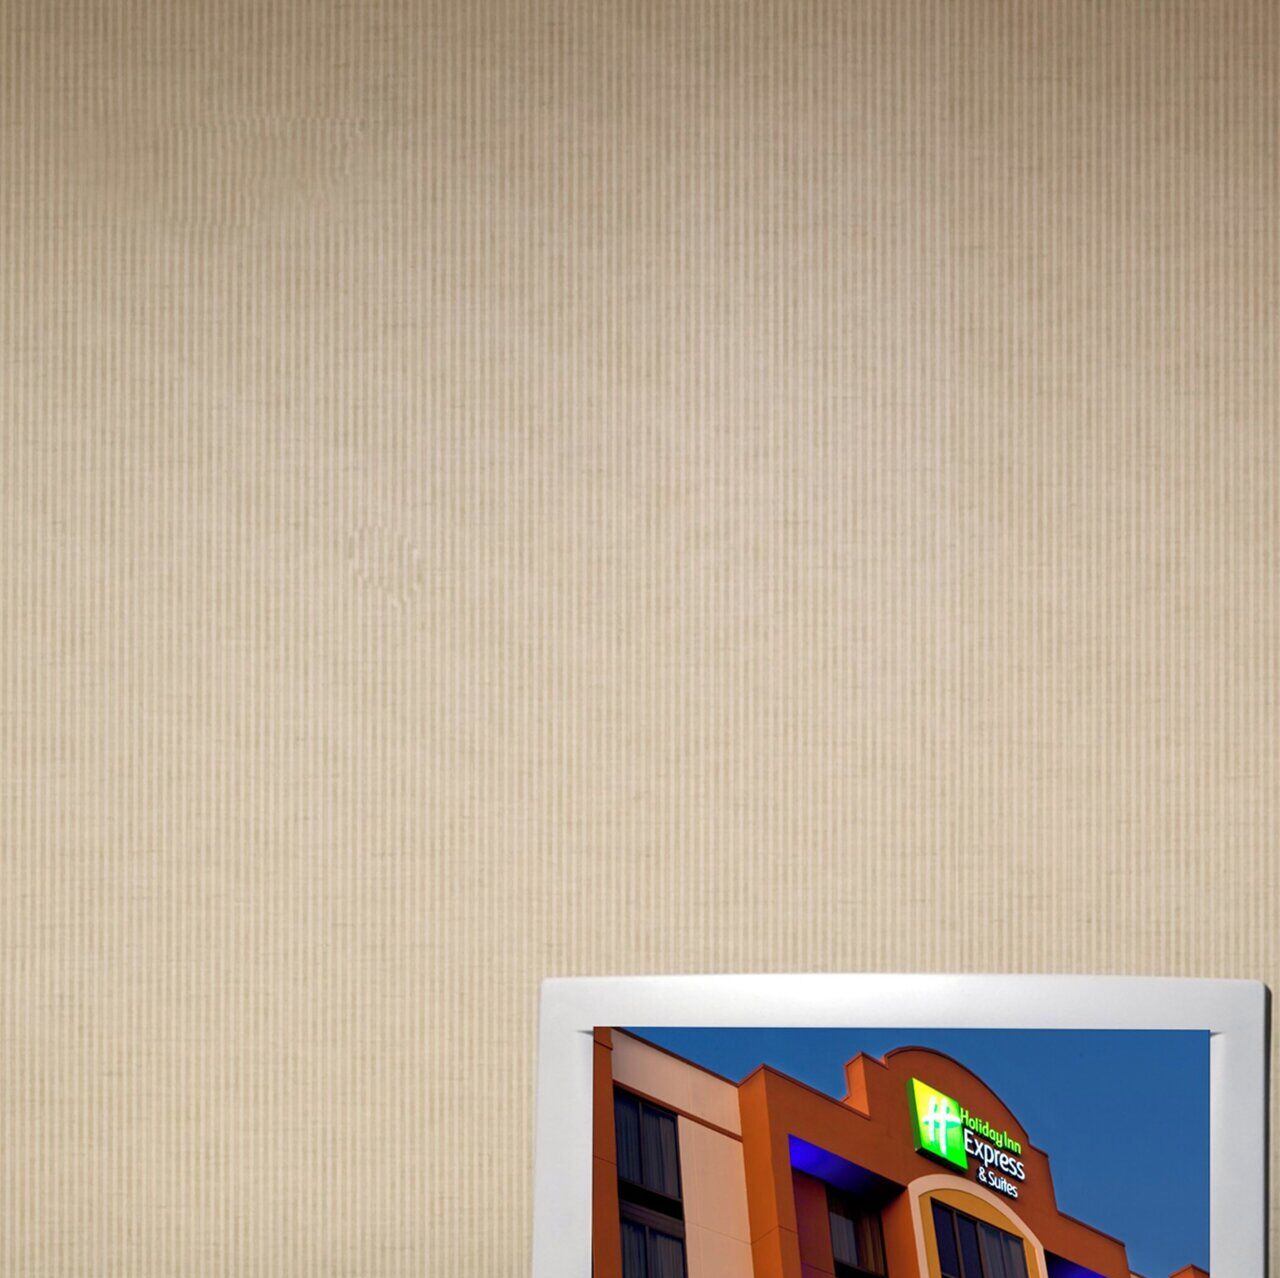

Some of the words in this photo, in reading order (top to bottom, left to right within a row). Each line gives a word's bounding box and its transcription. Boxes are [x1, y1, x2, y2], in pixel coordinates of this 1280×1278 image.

[960, 1107, 1003, 1147] Holiday
[1004, 1131, 1021, 1154] Inn
[963, 1128, 1025, 1180] Express
[978, 1167, 988, 1182] &
[989, 1172, 1018, 1198] Suites
